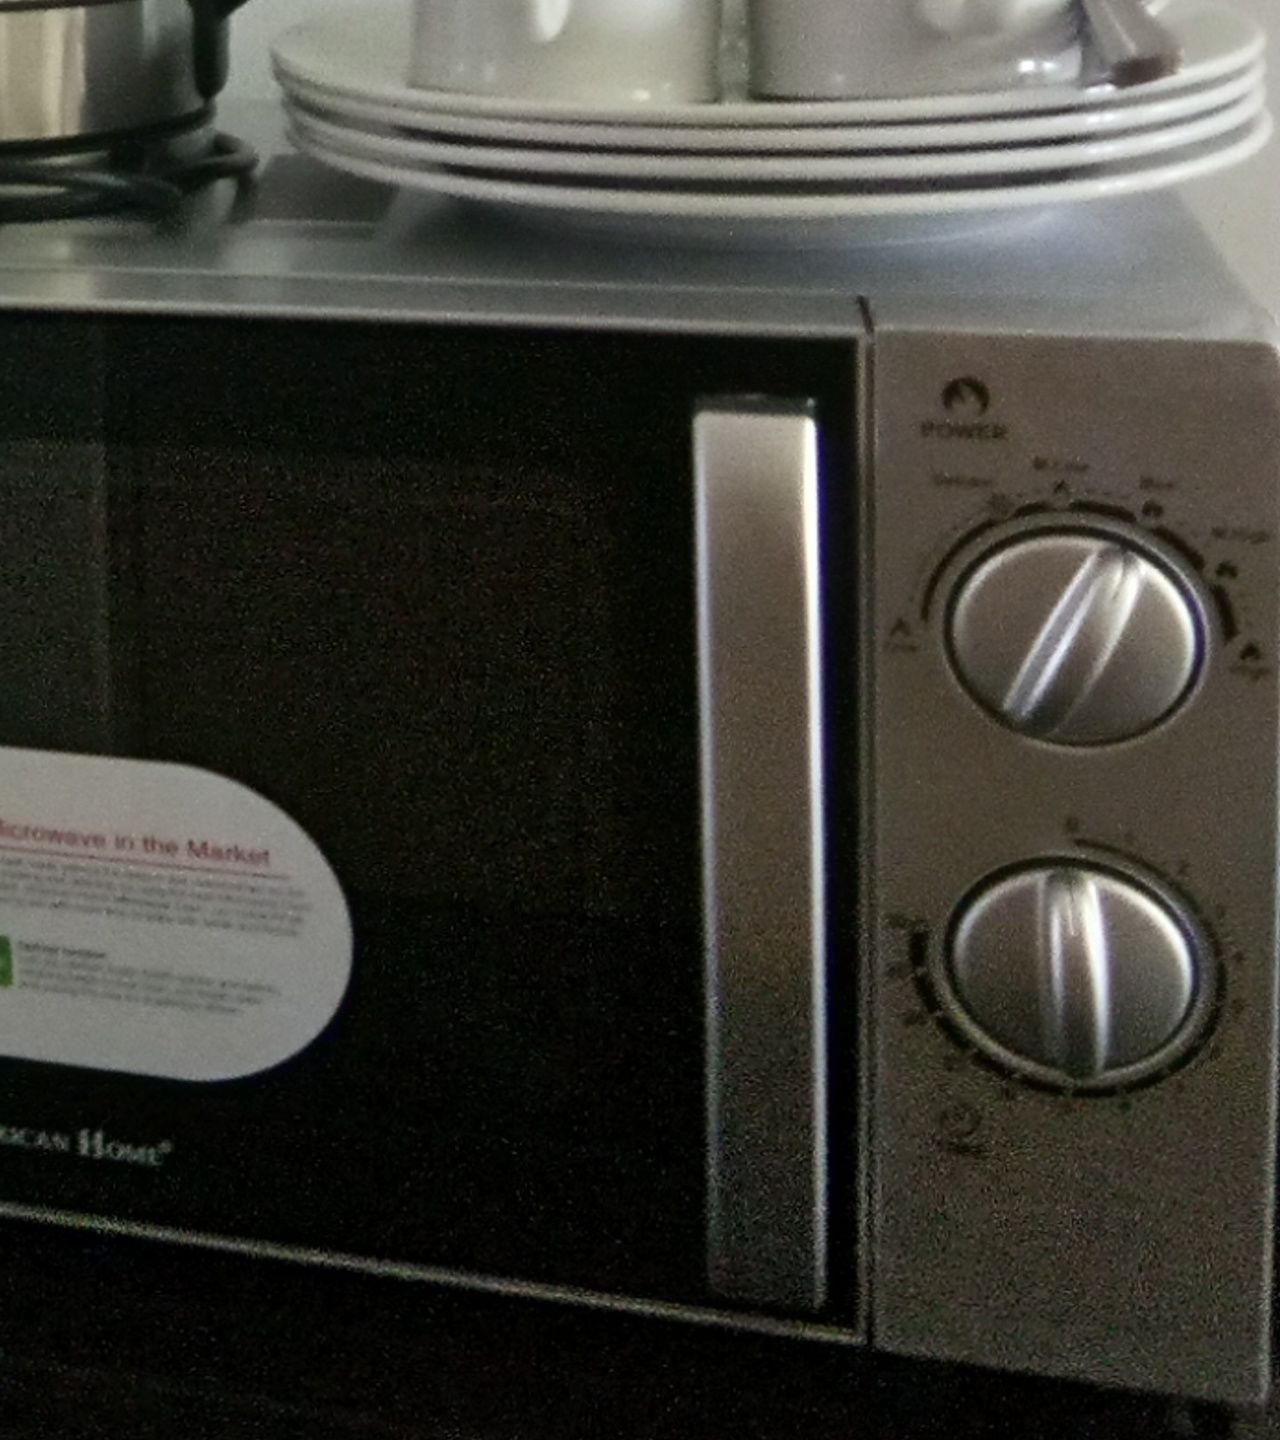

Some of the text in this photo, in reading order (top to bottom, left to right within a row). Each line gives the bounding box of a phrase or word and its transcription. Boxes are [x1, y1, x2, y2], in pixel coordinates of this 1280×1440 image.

[114, 835, 136, 852] in
[142, 834, 180, 858] the
[186, 838, 271, 866] Market
